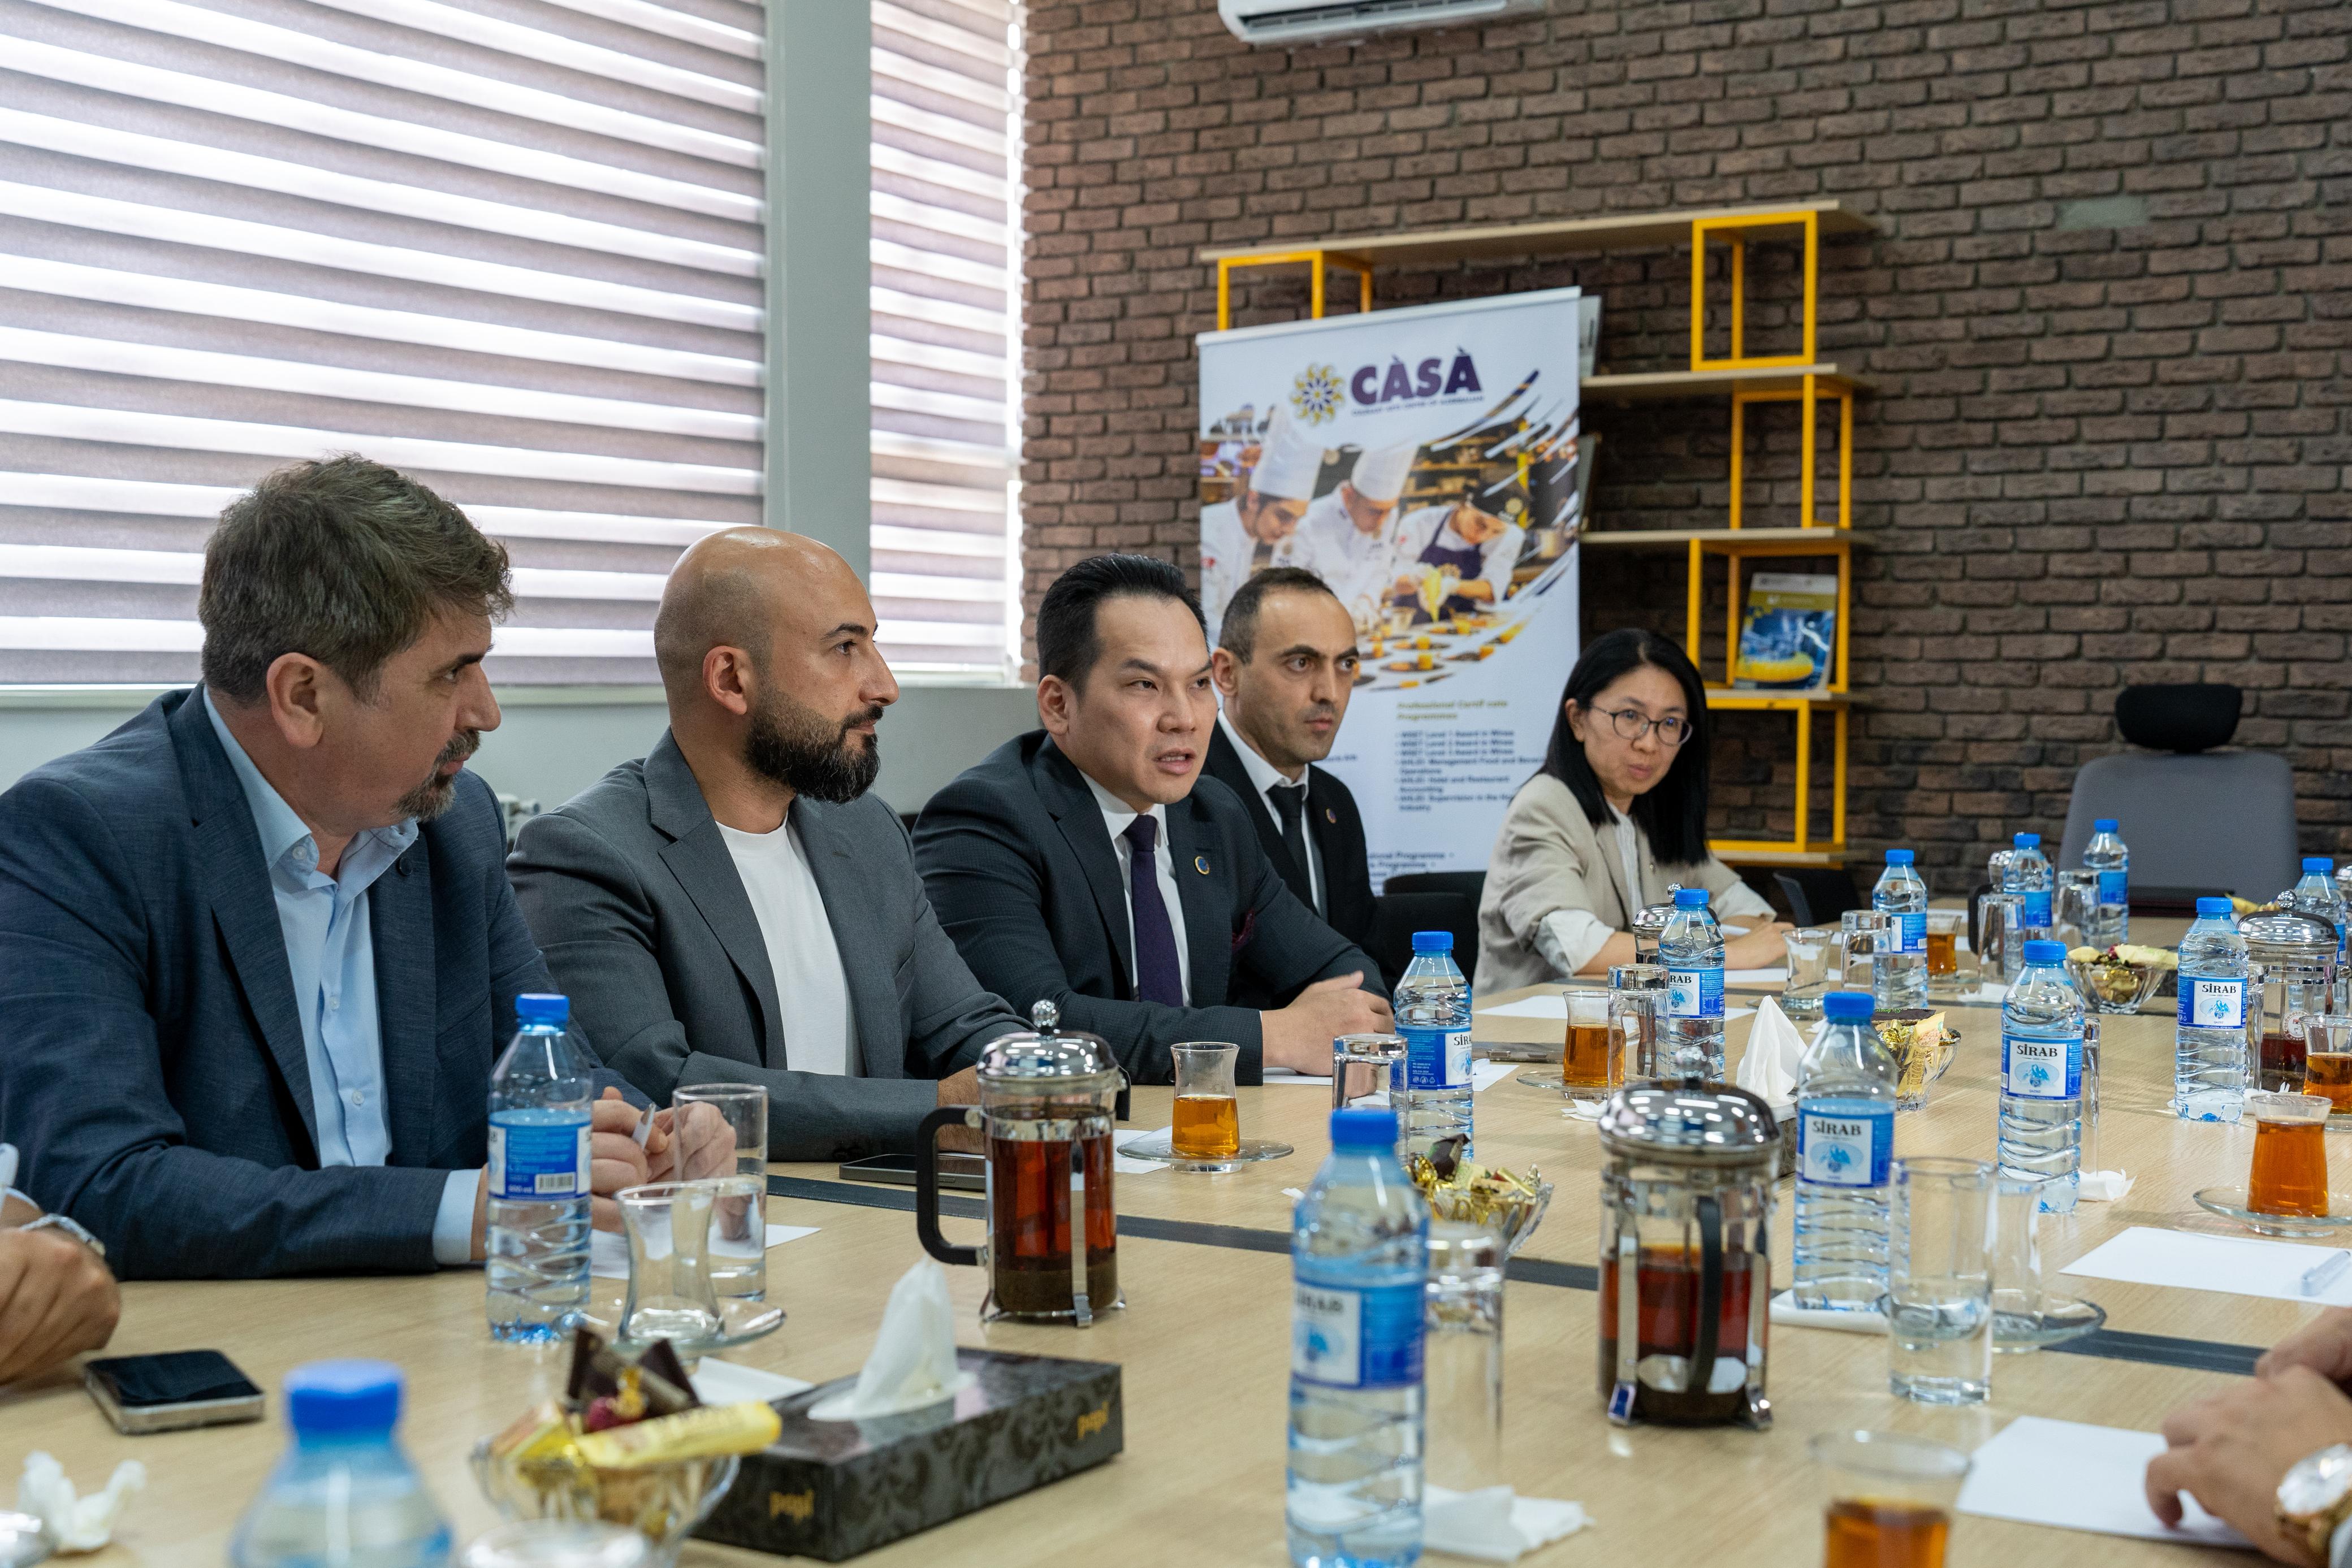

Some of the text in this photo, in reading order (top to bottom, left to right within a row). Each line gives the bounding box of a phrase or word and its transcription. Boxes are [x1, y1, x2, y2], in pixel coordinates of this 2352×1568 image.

[1670, 975, 1692, 984] RAB
[2202, 984, 2236, 994] SİRAB
[2017, 1044, 2057, 1057] SİRAB
